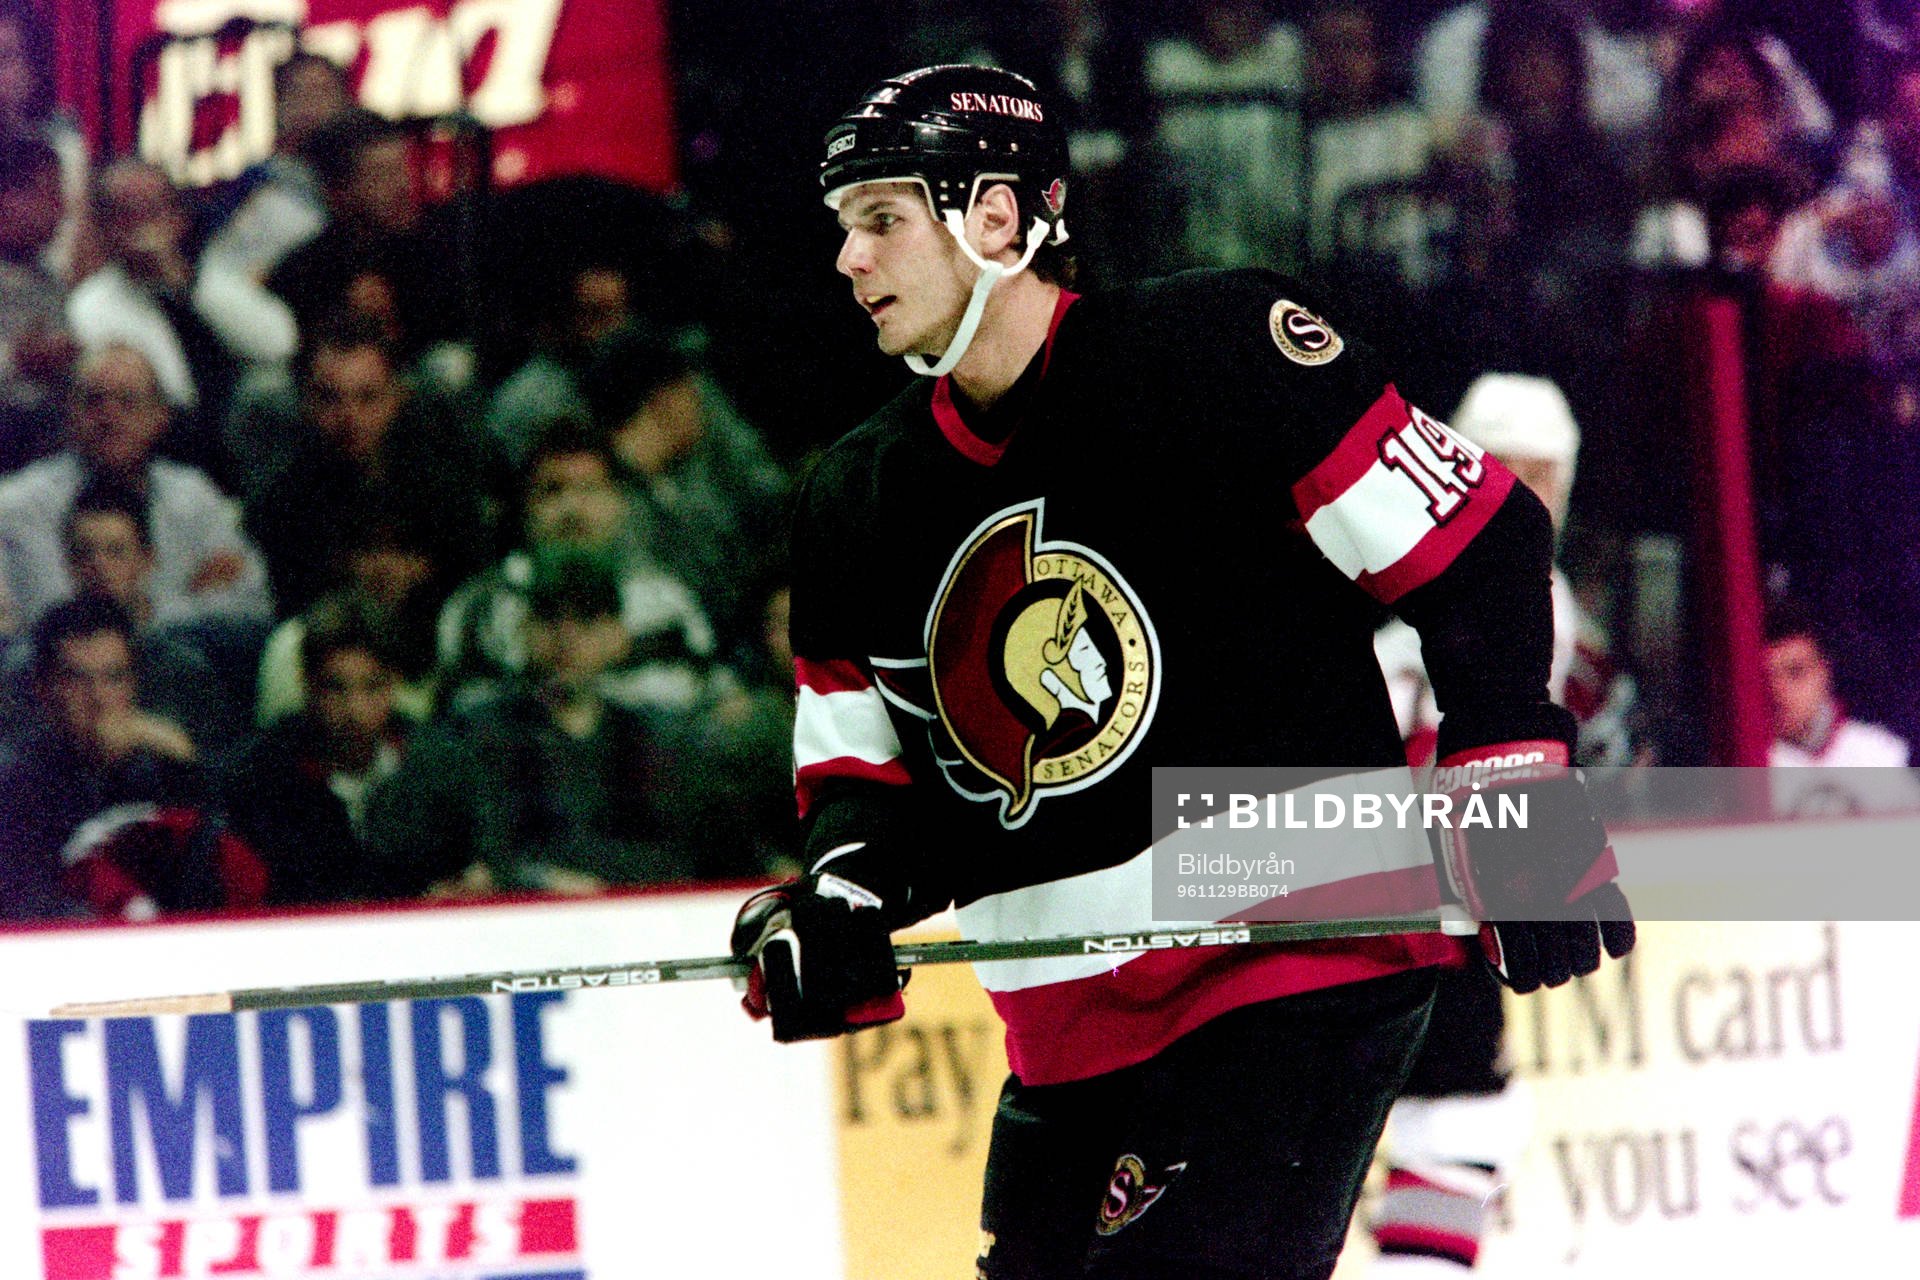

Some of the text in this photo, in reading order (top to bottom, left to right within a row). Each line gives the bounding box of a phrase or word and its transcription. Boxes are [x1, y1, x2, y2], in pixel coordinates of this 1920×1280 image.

[951, 92, 1044, 122] SENATORS
[1036, 559, 1129, 628] OTTAWA
[1042, 659, 1146, 780] SENATORS
[491, 970, 625, 994] EASTON
[1084, 931, 1220, 954] EASTON
[1672, 918, 1843, 1064] card
[24, 988, 579, 1212] EMPIRE
[843, 1022, 990, 1156] Pay
[1551, 1127, 1699, 1263] you
[1728, 1115, 1852, 1212] see
